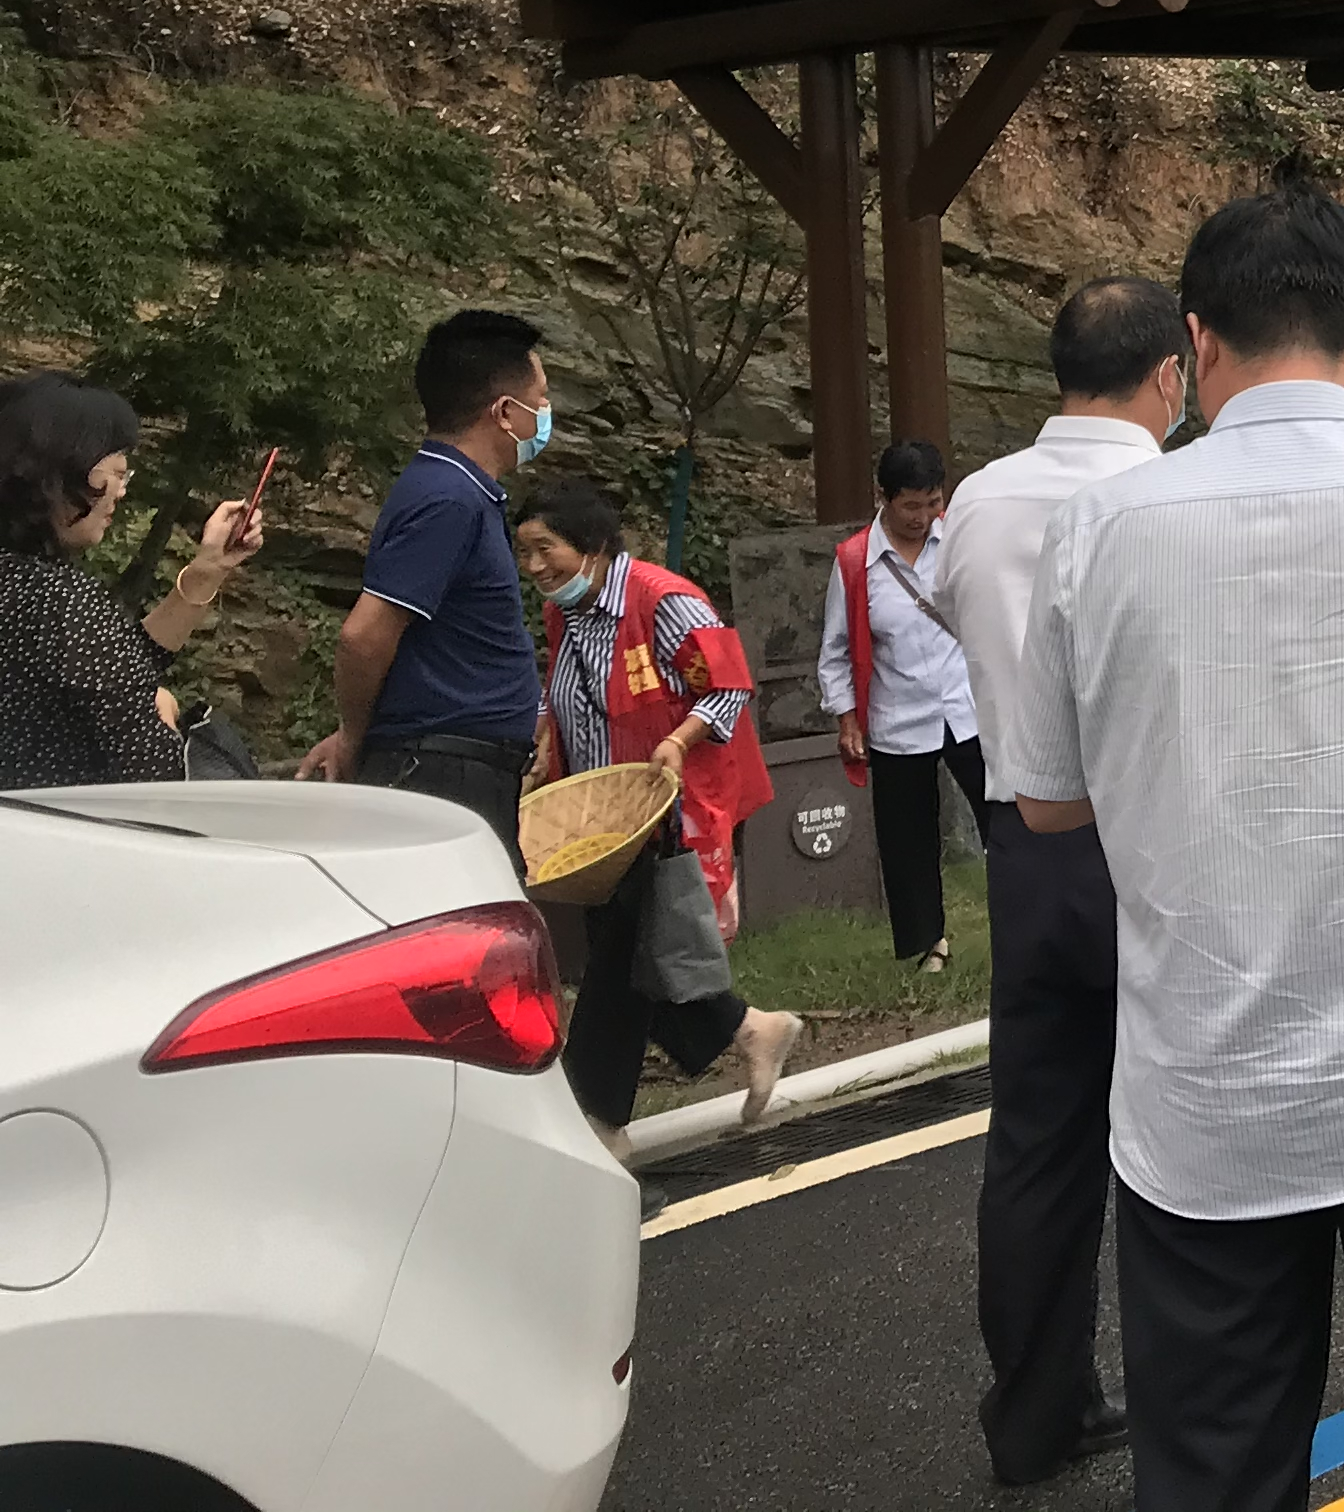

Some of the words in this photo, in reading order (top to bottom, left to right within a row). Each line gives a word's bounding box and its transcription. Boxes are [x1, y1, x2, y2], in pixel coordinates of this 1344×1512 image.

[797, 805, 846, 825] 可回收物
[802, 820, 842, 834] Recyclable
